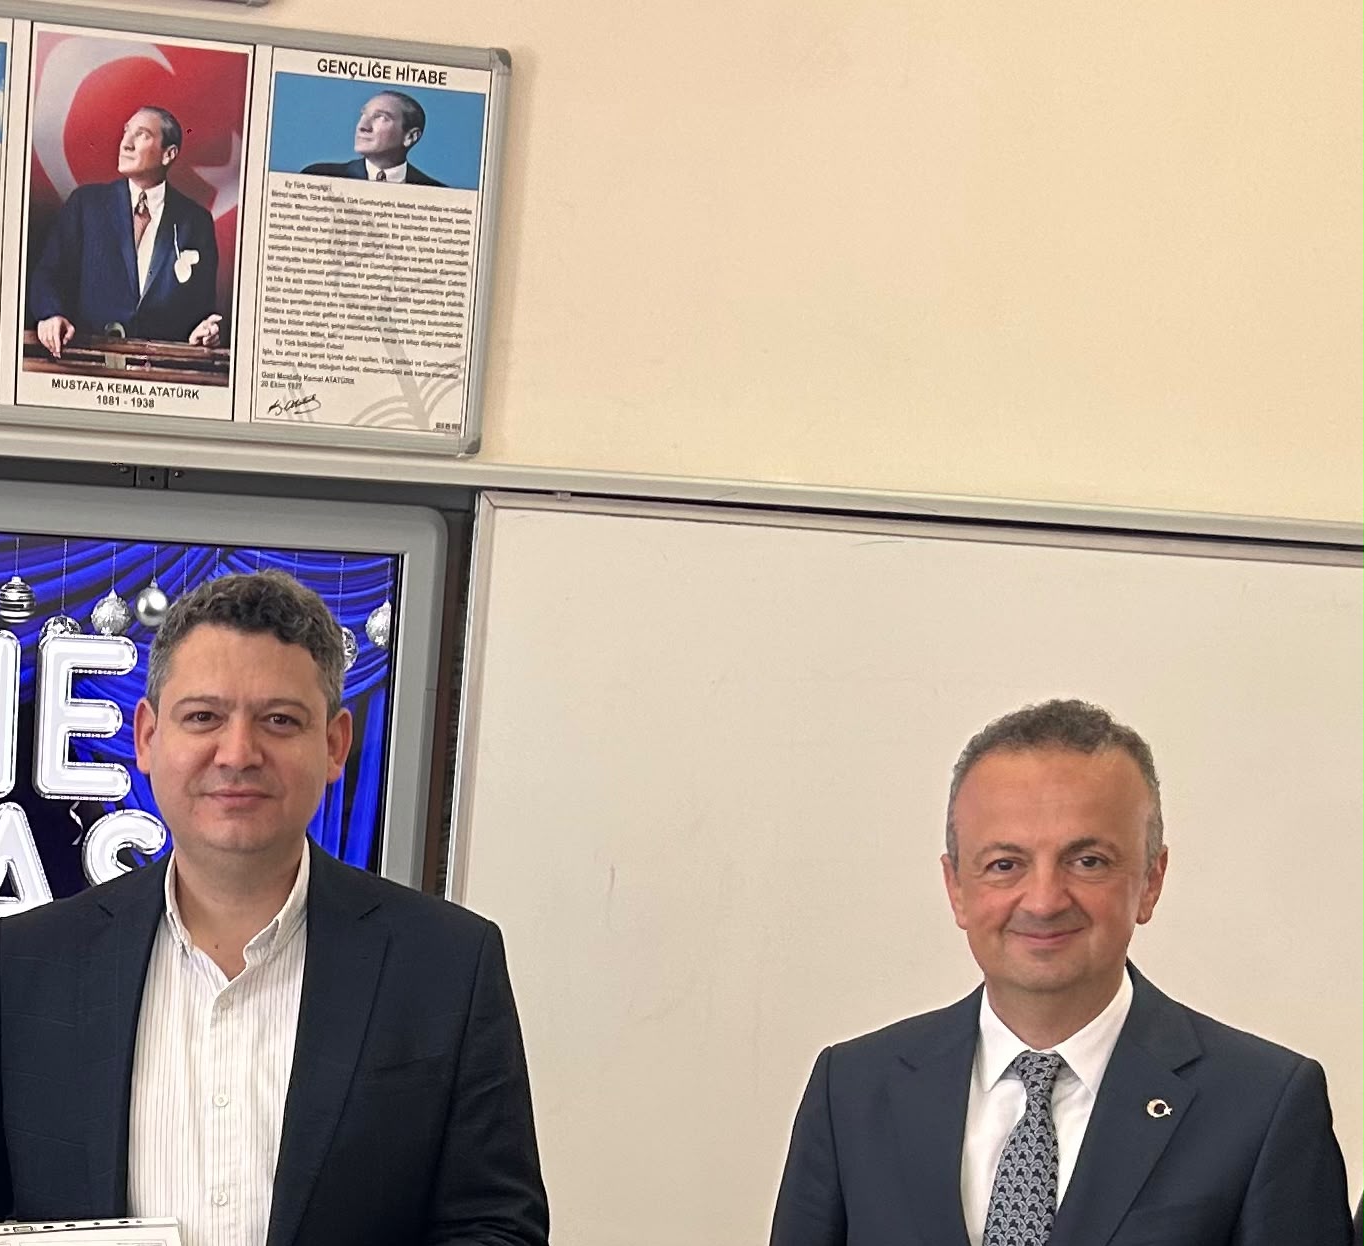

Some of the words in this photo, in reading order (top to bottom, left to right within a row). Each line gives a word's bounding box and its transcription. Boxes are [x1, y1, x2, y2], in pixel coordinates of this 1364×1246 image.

[317, 57, 392, 80] GENÇLİĞE
[395, 63, 448, 86] HİTABE
[51, 378, 104, 393] MUSTAFA
[107, 382, 146, 396] KEMAL
[149, 386, 200, 400] ATATÜRK
[96, 394, 120, 406] 1881
[130, 397, 155, 409] 1938
